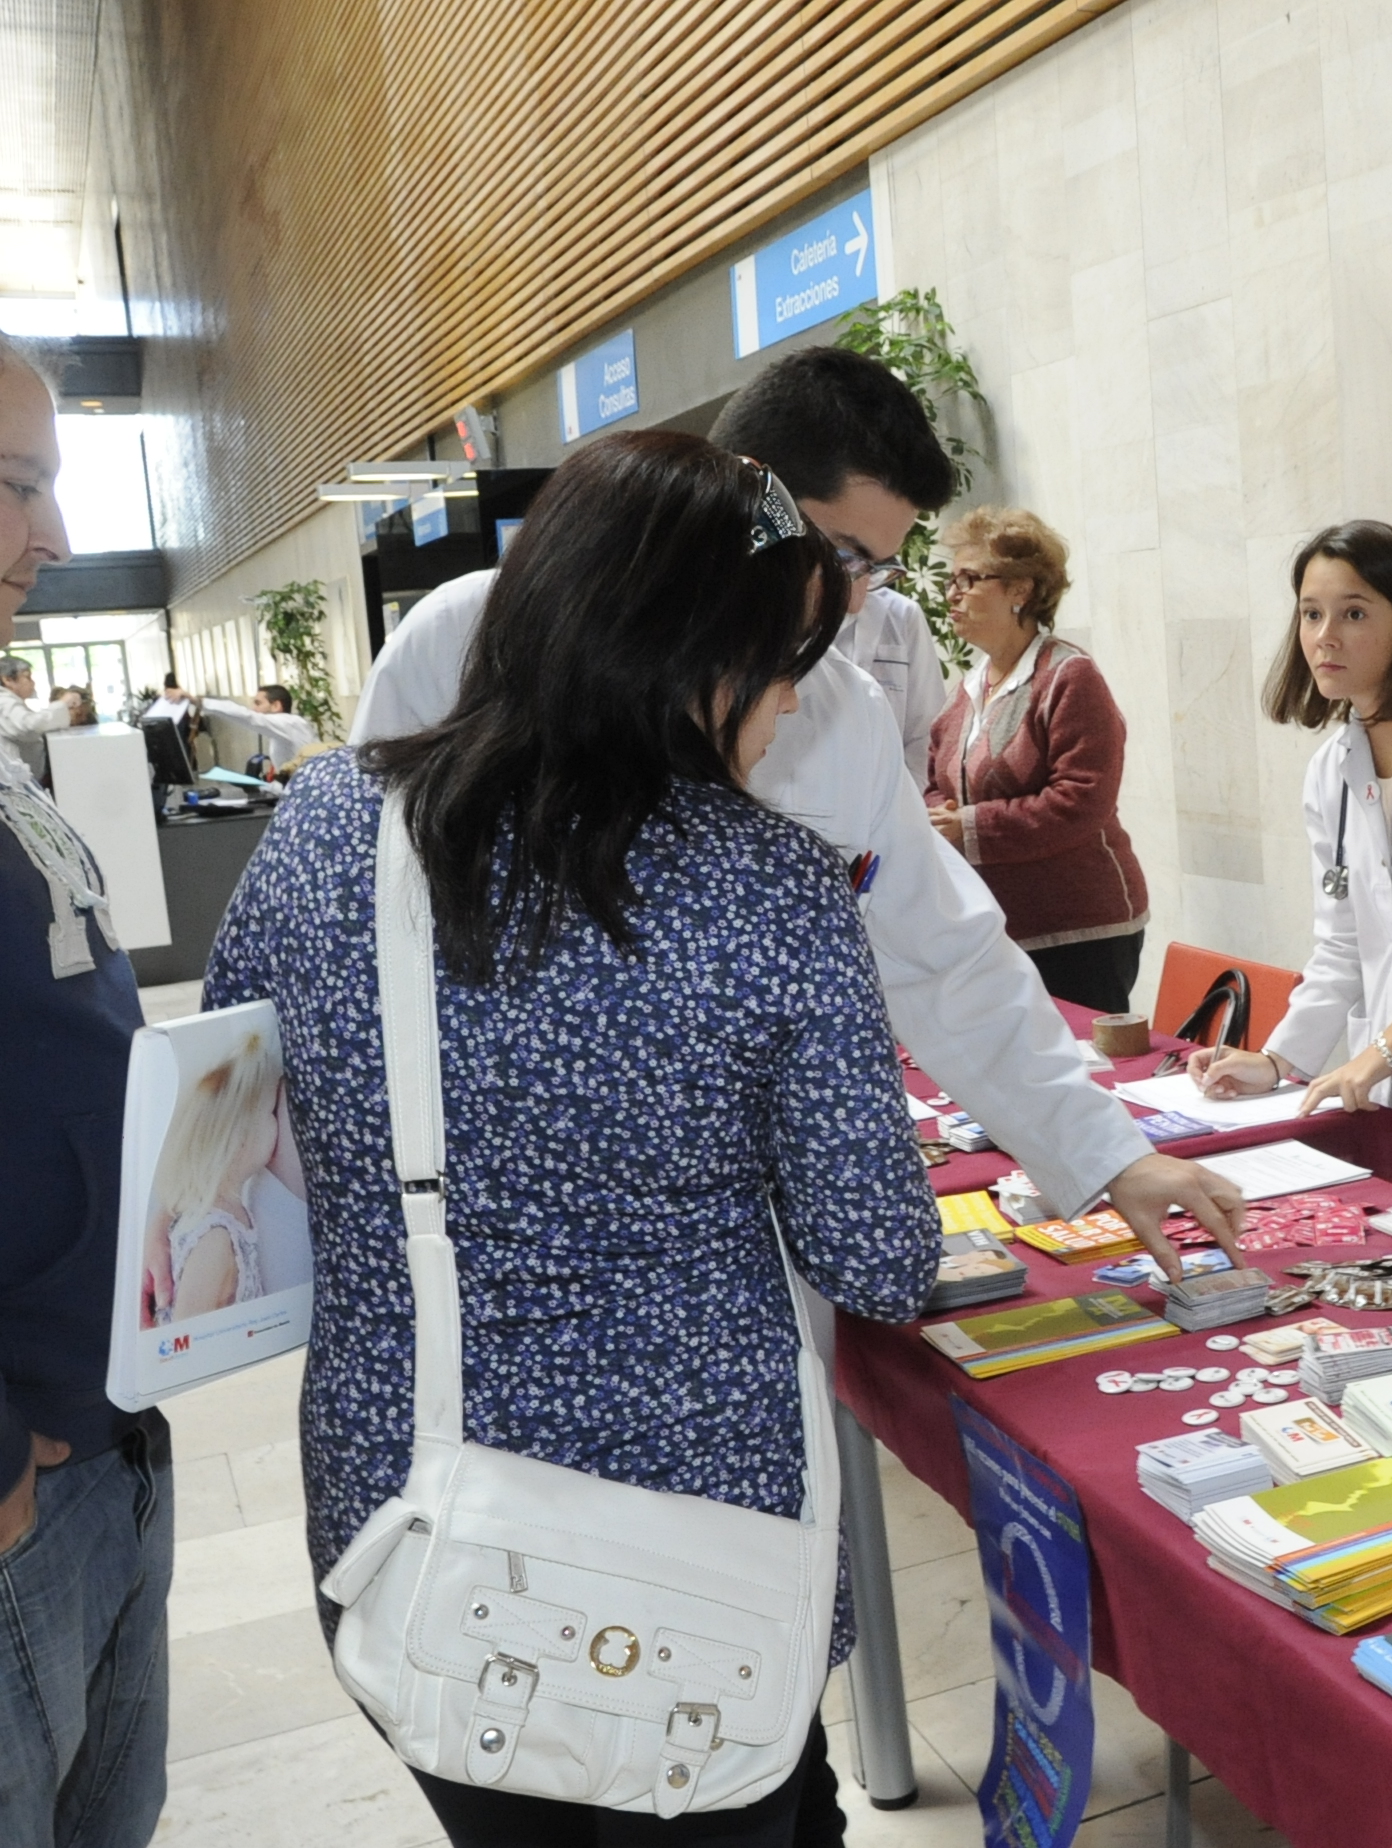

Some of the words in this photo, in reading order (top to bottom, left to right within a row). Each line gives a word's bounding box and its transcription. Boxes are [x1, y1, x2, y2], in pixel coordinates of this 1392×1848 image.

[791, 229, 838, 276] Cafetería
[775, 275, 840, 323] Extracciones
[603, 356, 631, 388] Acceso
[599, 384, 637, 420] Consultas
[1037, 1224, 1097, 1249] SALUD
